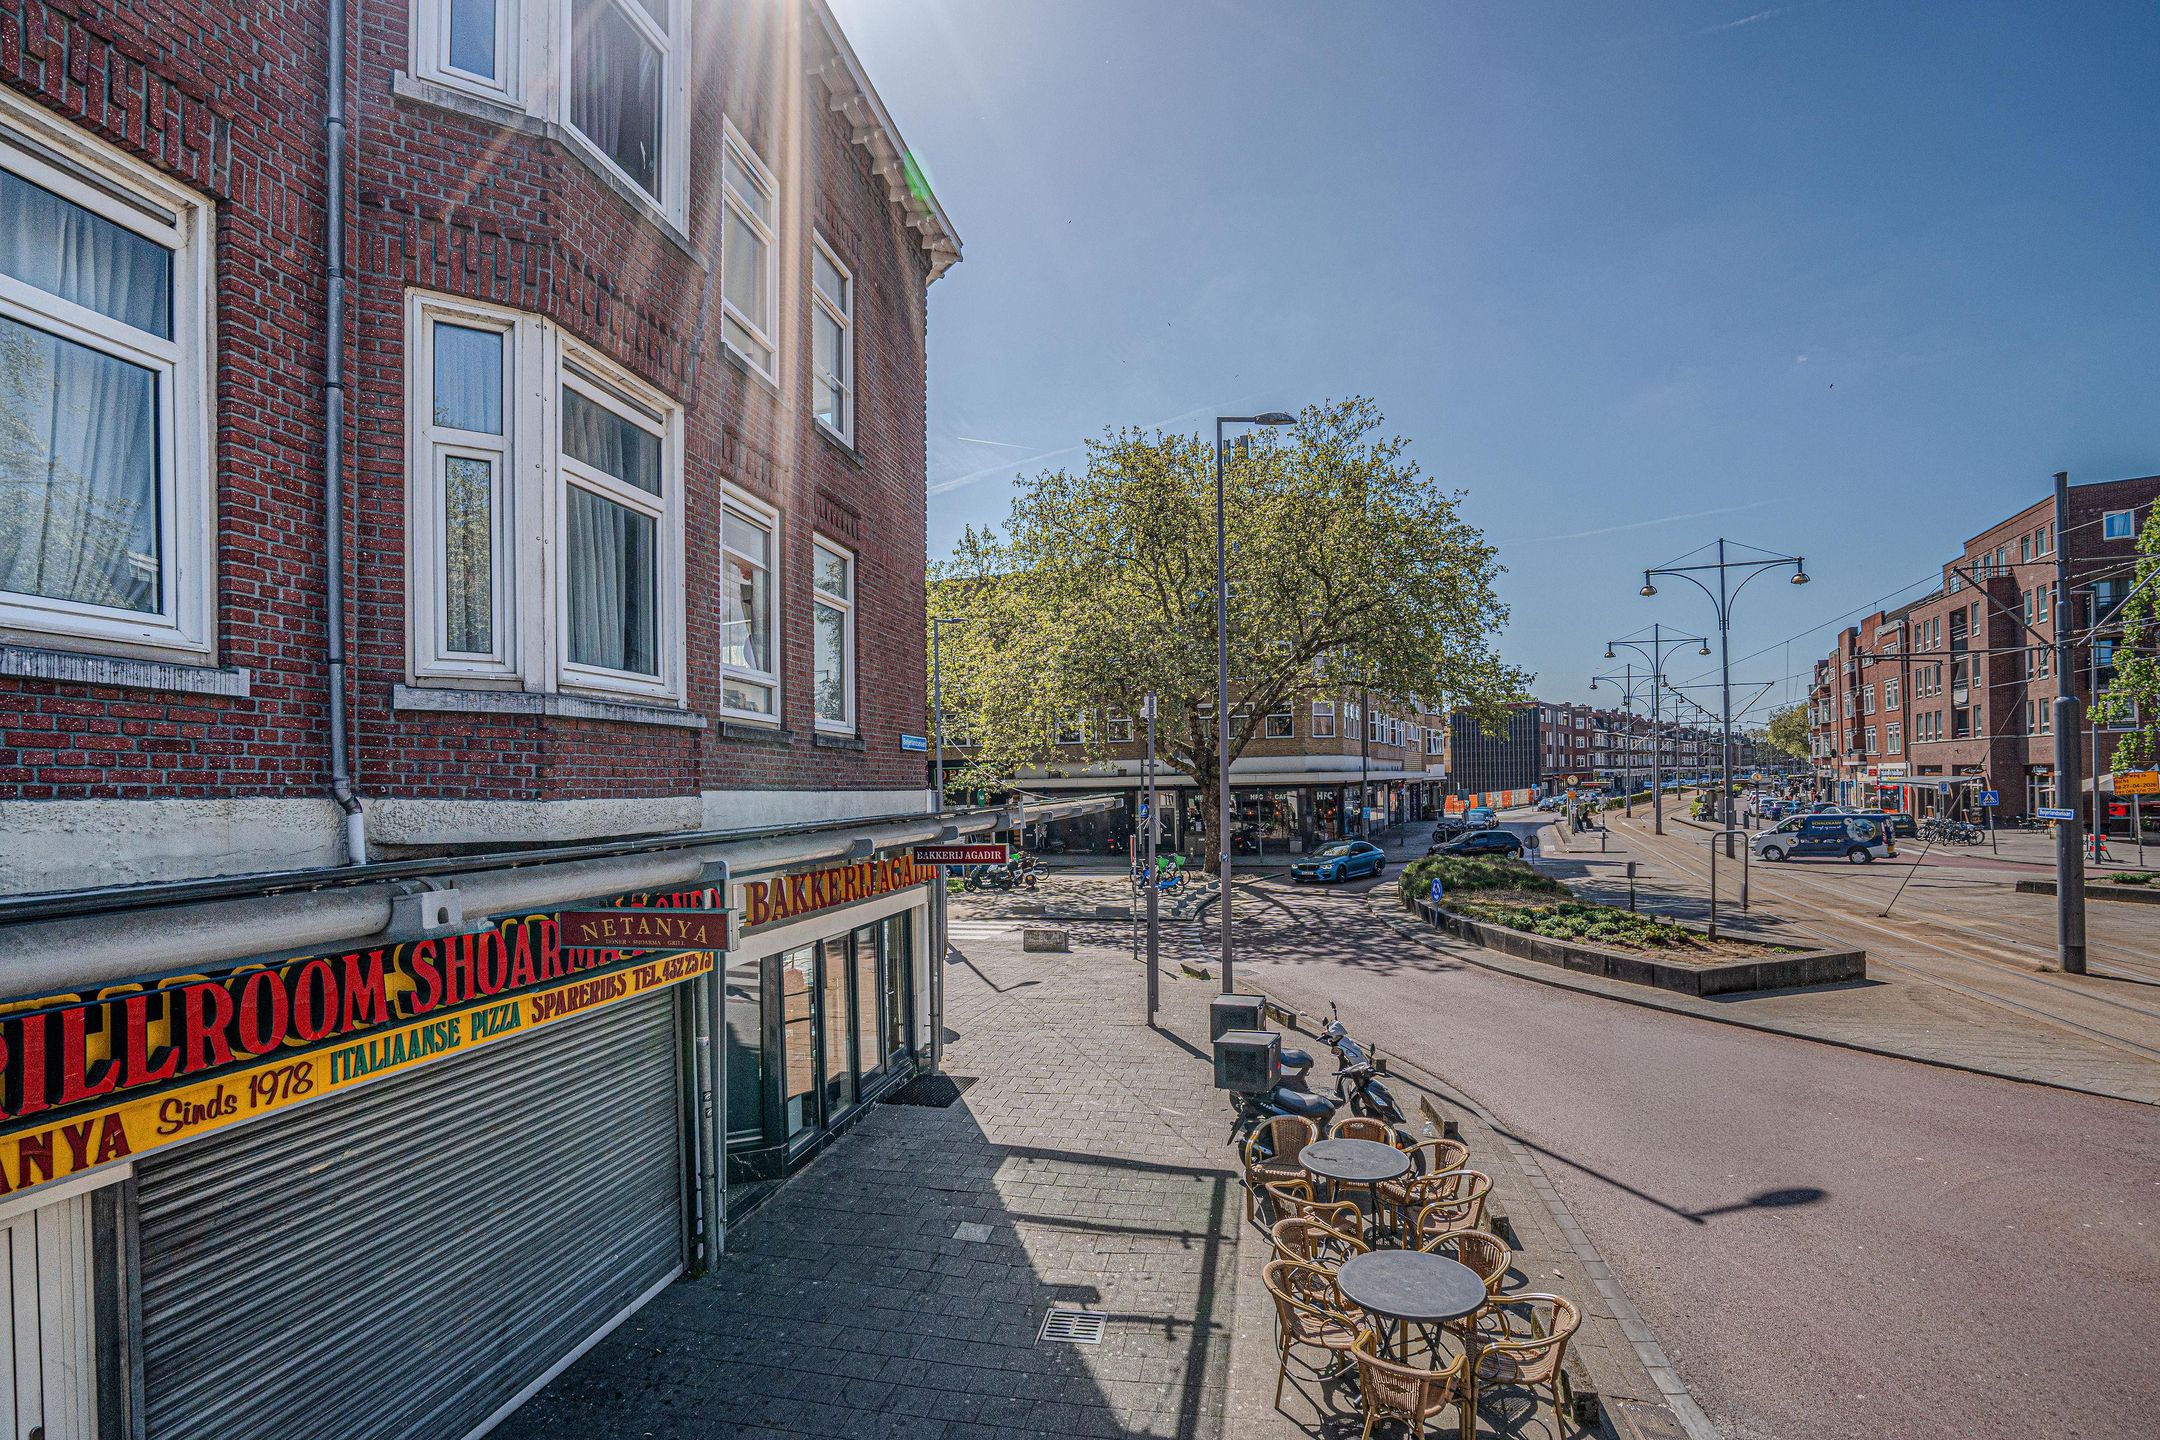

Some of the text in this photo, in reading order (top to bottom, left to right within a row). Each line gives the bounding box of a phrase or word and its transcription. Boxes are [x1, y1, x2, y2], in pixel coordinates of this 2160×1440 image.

[1316, 791, 1333, 800] HFC
[917, 850, 1001, 860] BAKKERIJ AGADIR
[751, 862, 875, 926] BAKKERIJ
[580, 917, 708, 944] NETANYA
[0, 949, 389, 1120] ILLROOM
[157, 1084, 238, 1135] Sinds
[249, 1061, 314, 1108] 1978
[330, 1016, 461, 1085] ITALIAANSE
[471, 1001, 522, 1042] PIZZA
[531, 972, 627, 1024] SPARERIBS
[632, 964, 662, 991] TEL.
